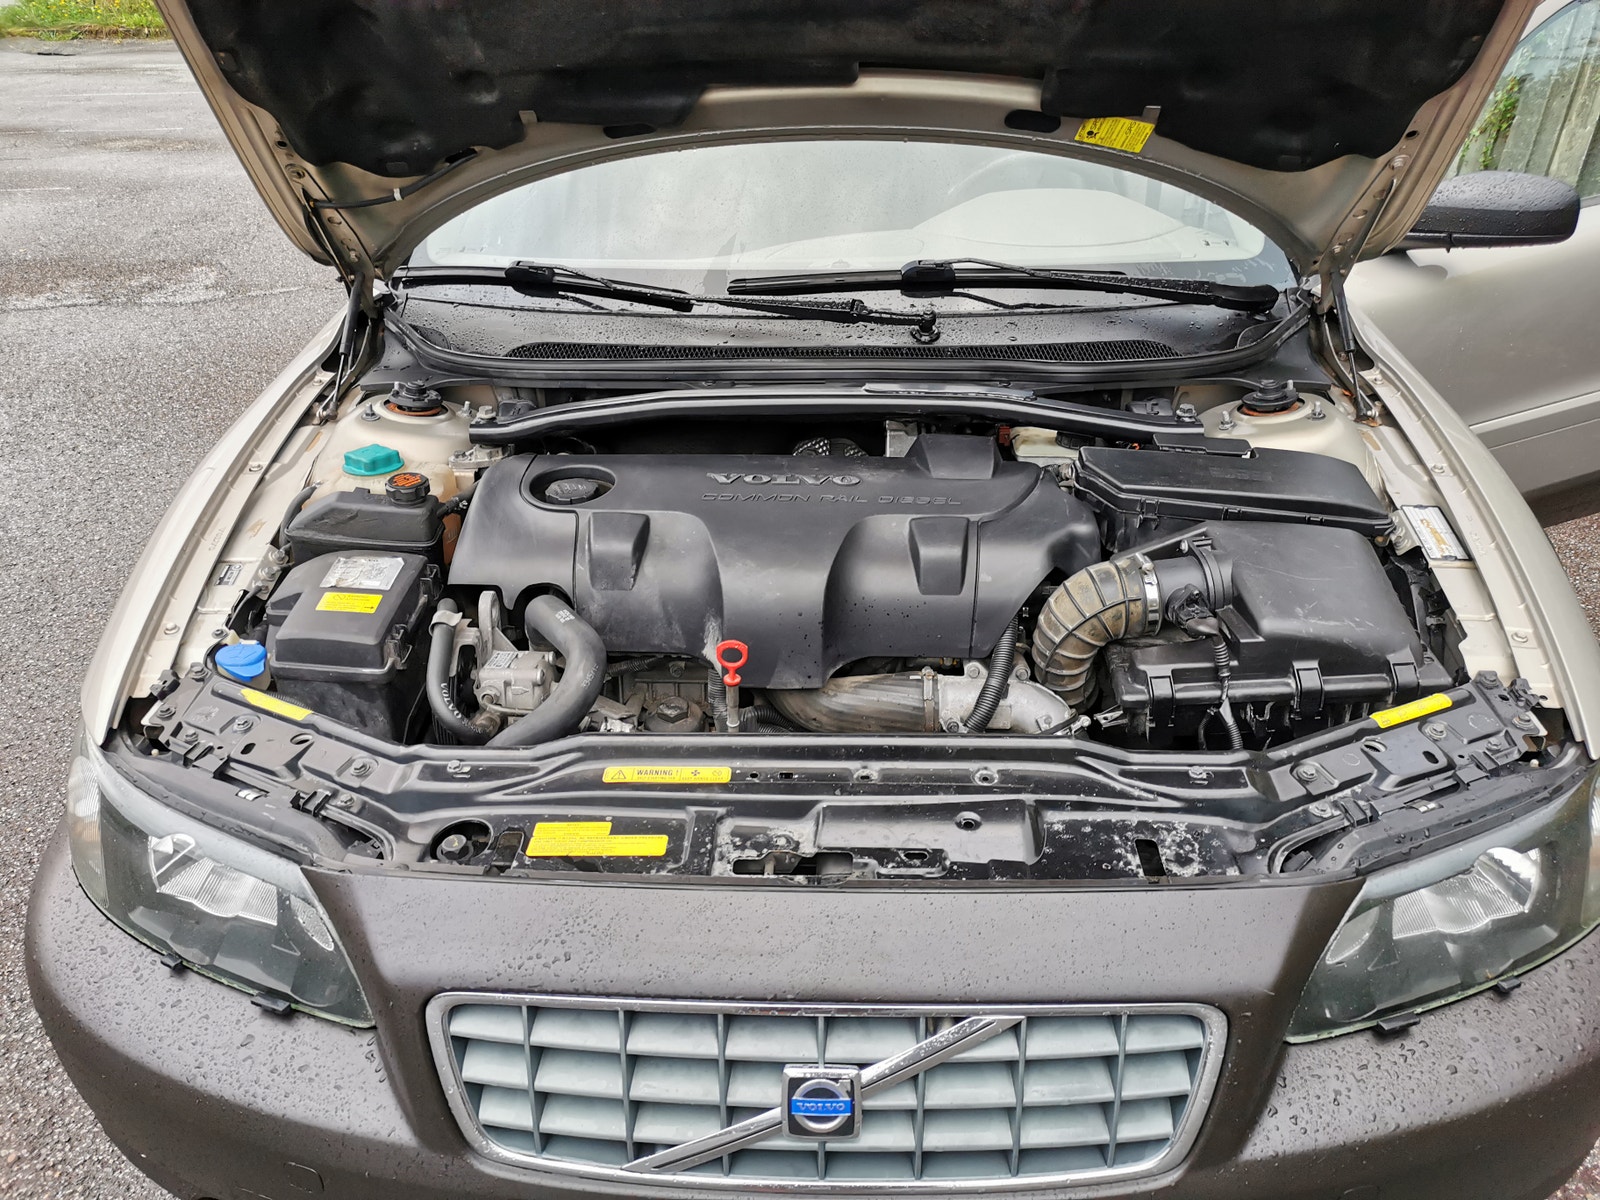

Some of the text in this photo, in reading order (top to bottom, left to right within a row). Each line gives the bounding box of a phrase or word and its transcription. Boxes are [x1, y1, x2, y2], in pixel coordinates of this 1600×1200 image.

[706, 472, 862, 486] VOLVO
[701, 493, 962, 505] COMMON RAIL DIESEL
[440, 682, 462, 719] VOLVO
[796, 1102, 846, 1111] VOLVO
